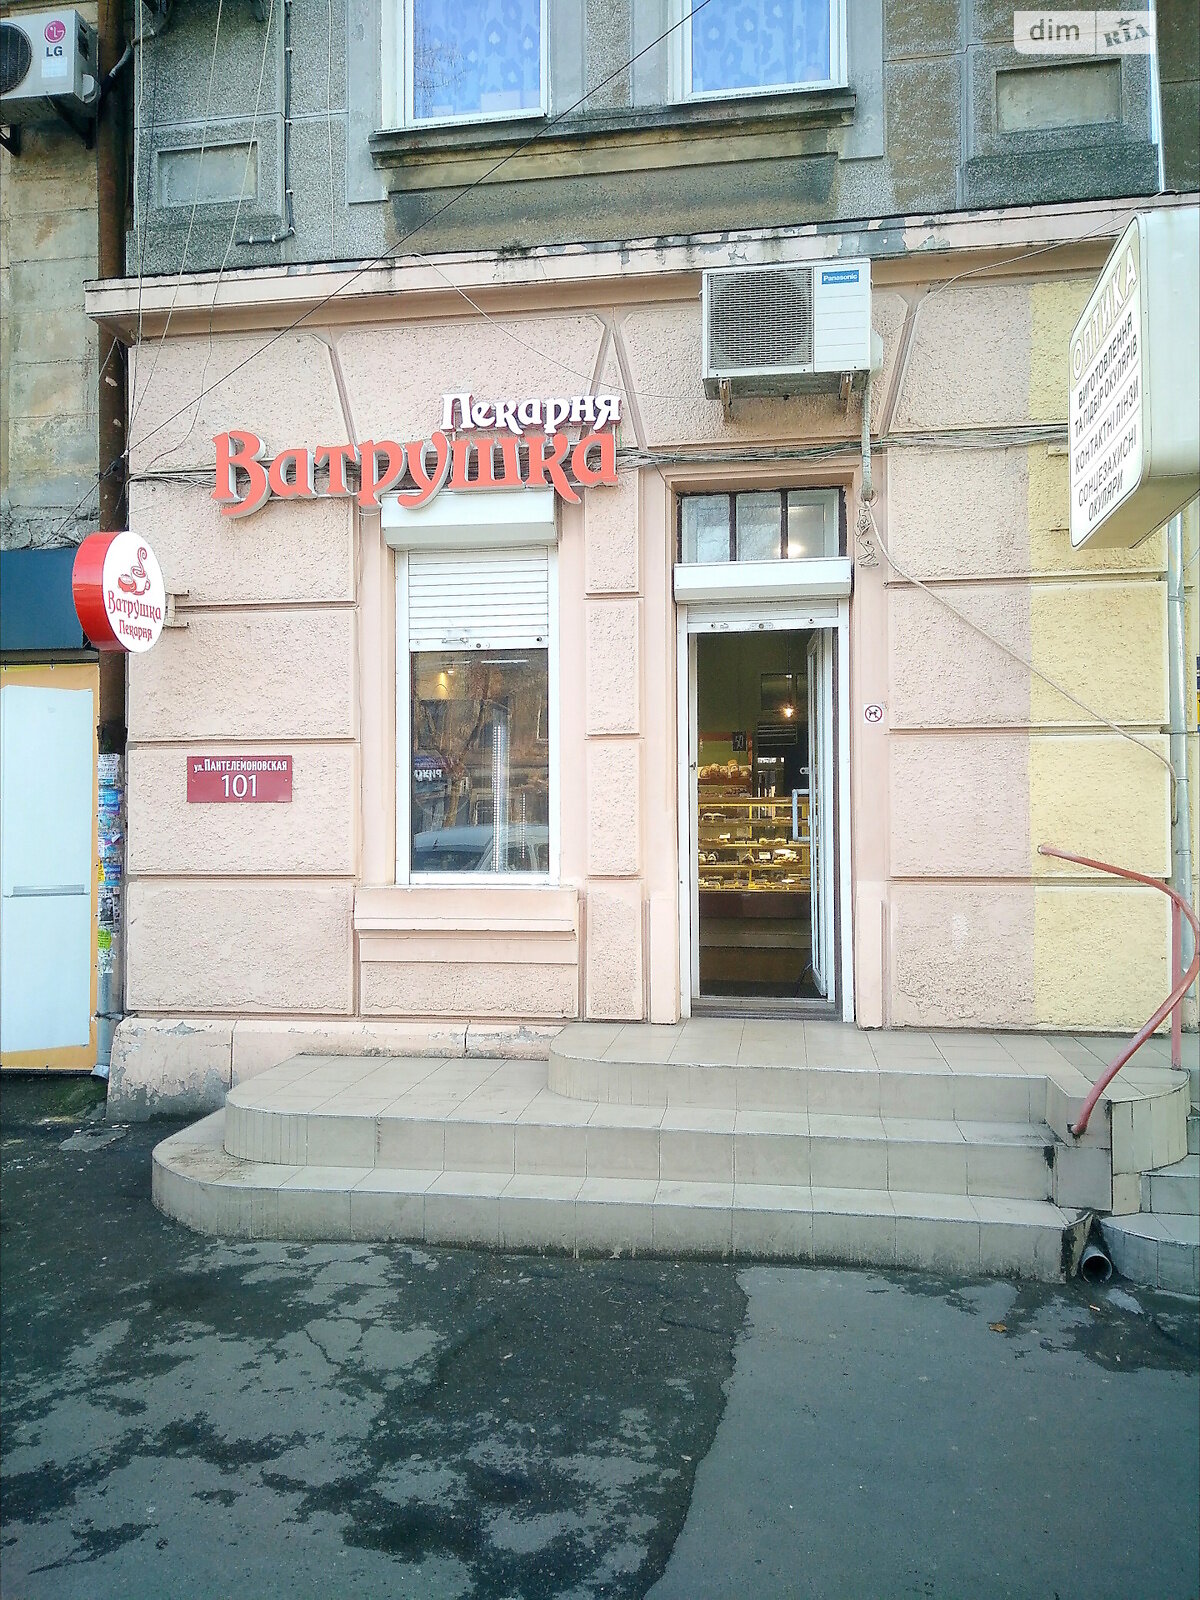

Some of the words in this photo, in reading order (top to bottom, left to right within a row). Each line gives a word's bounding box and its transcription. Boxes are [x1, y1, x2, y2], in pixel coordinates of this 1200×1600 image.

[45, 45, 63, 58] LG
[823, 273, 858, 282] Panasonic
[1072, 244, 1138, 382] ОПТИКА
[1074, 415, 1084, 438] ТА
[1083, 385, 1105, 429] ПІДБІР
[1104, 333, 1138, 399] ОКУЛЯРІВ
[1078, 311, 1133, 410] ВИГОТОВЛЕННЯ
[440, 392, 622, 435] Пекарня
[1075, 410, 1115, 475] КОНТАКТНІ
[1115, 374, 1139, 428] ЛІНЗИ
[210, 429, 620, 518] Ватрушка
[1078, 423, 1137, 508] СОНЦЕЗАХИСНІ
[1088, 468, 1124, 522] ОКУЛЯРИ
[107, 590, 162, 624] Ватрушка
[118, 618, 153, 642] Пекарня
[221, 773, 257, 797] 101
